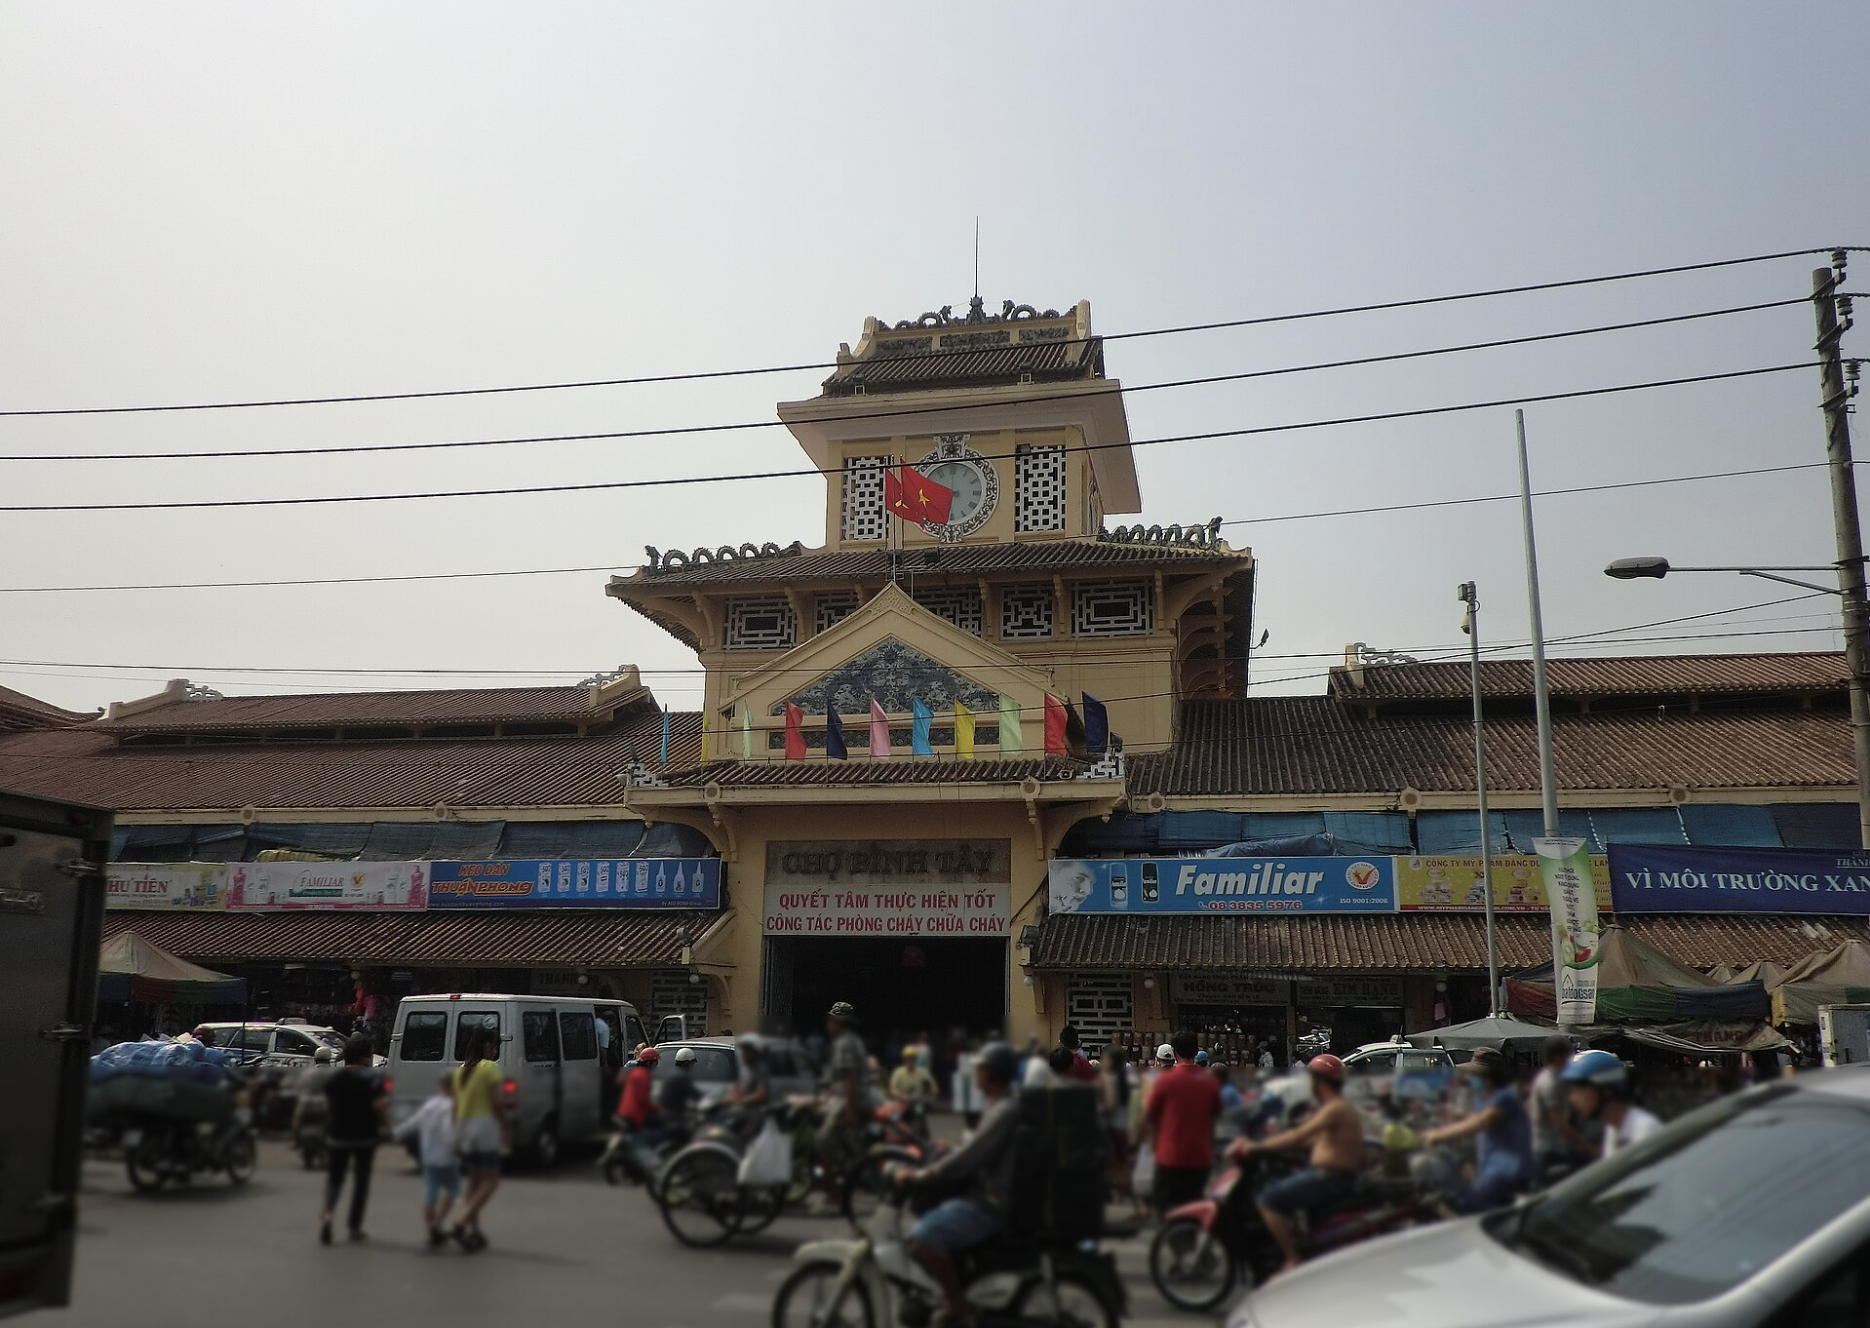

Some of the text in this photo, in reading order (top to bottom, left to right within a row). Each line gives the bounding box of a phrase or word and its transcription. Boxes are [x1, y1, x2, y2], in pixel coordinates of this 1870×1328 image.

[300, 876, 344, 887] FAMILIAR
[1176, 863, 1324, 895] Familiar
[1625, 868, 1870, 892] VÌ MÔI TRƯỜNG XAN
[779, 888, 996, 912] QUYẾT TÂM THỰC HIỆN TỐT
[1210, 901, 1302, 910] 08 3835 5976
[767, 912, 1005, 931] CÔNG TÁC PHÒNG CHÁY CHỮA CHÁY
